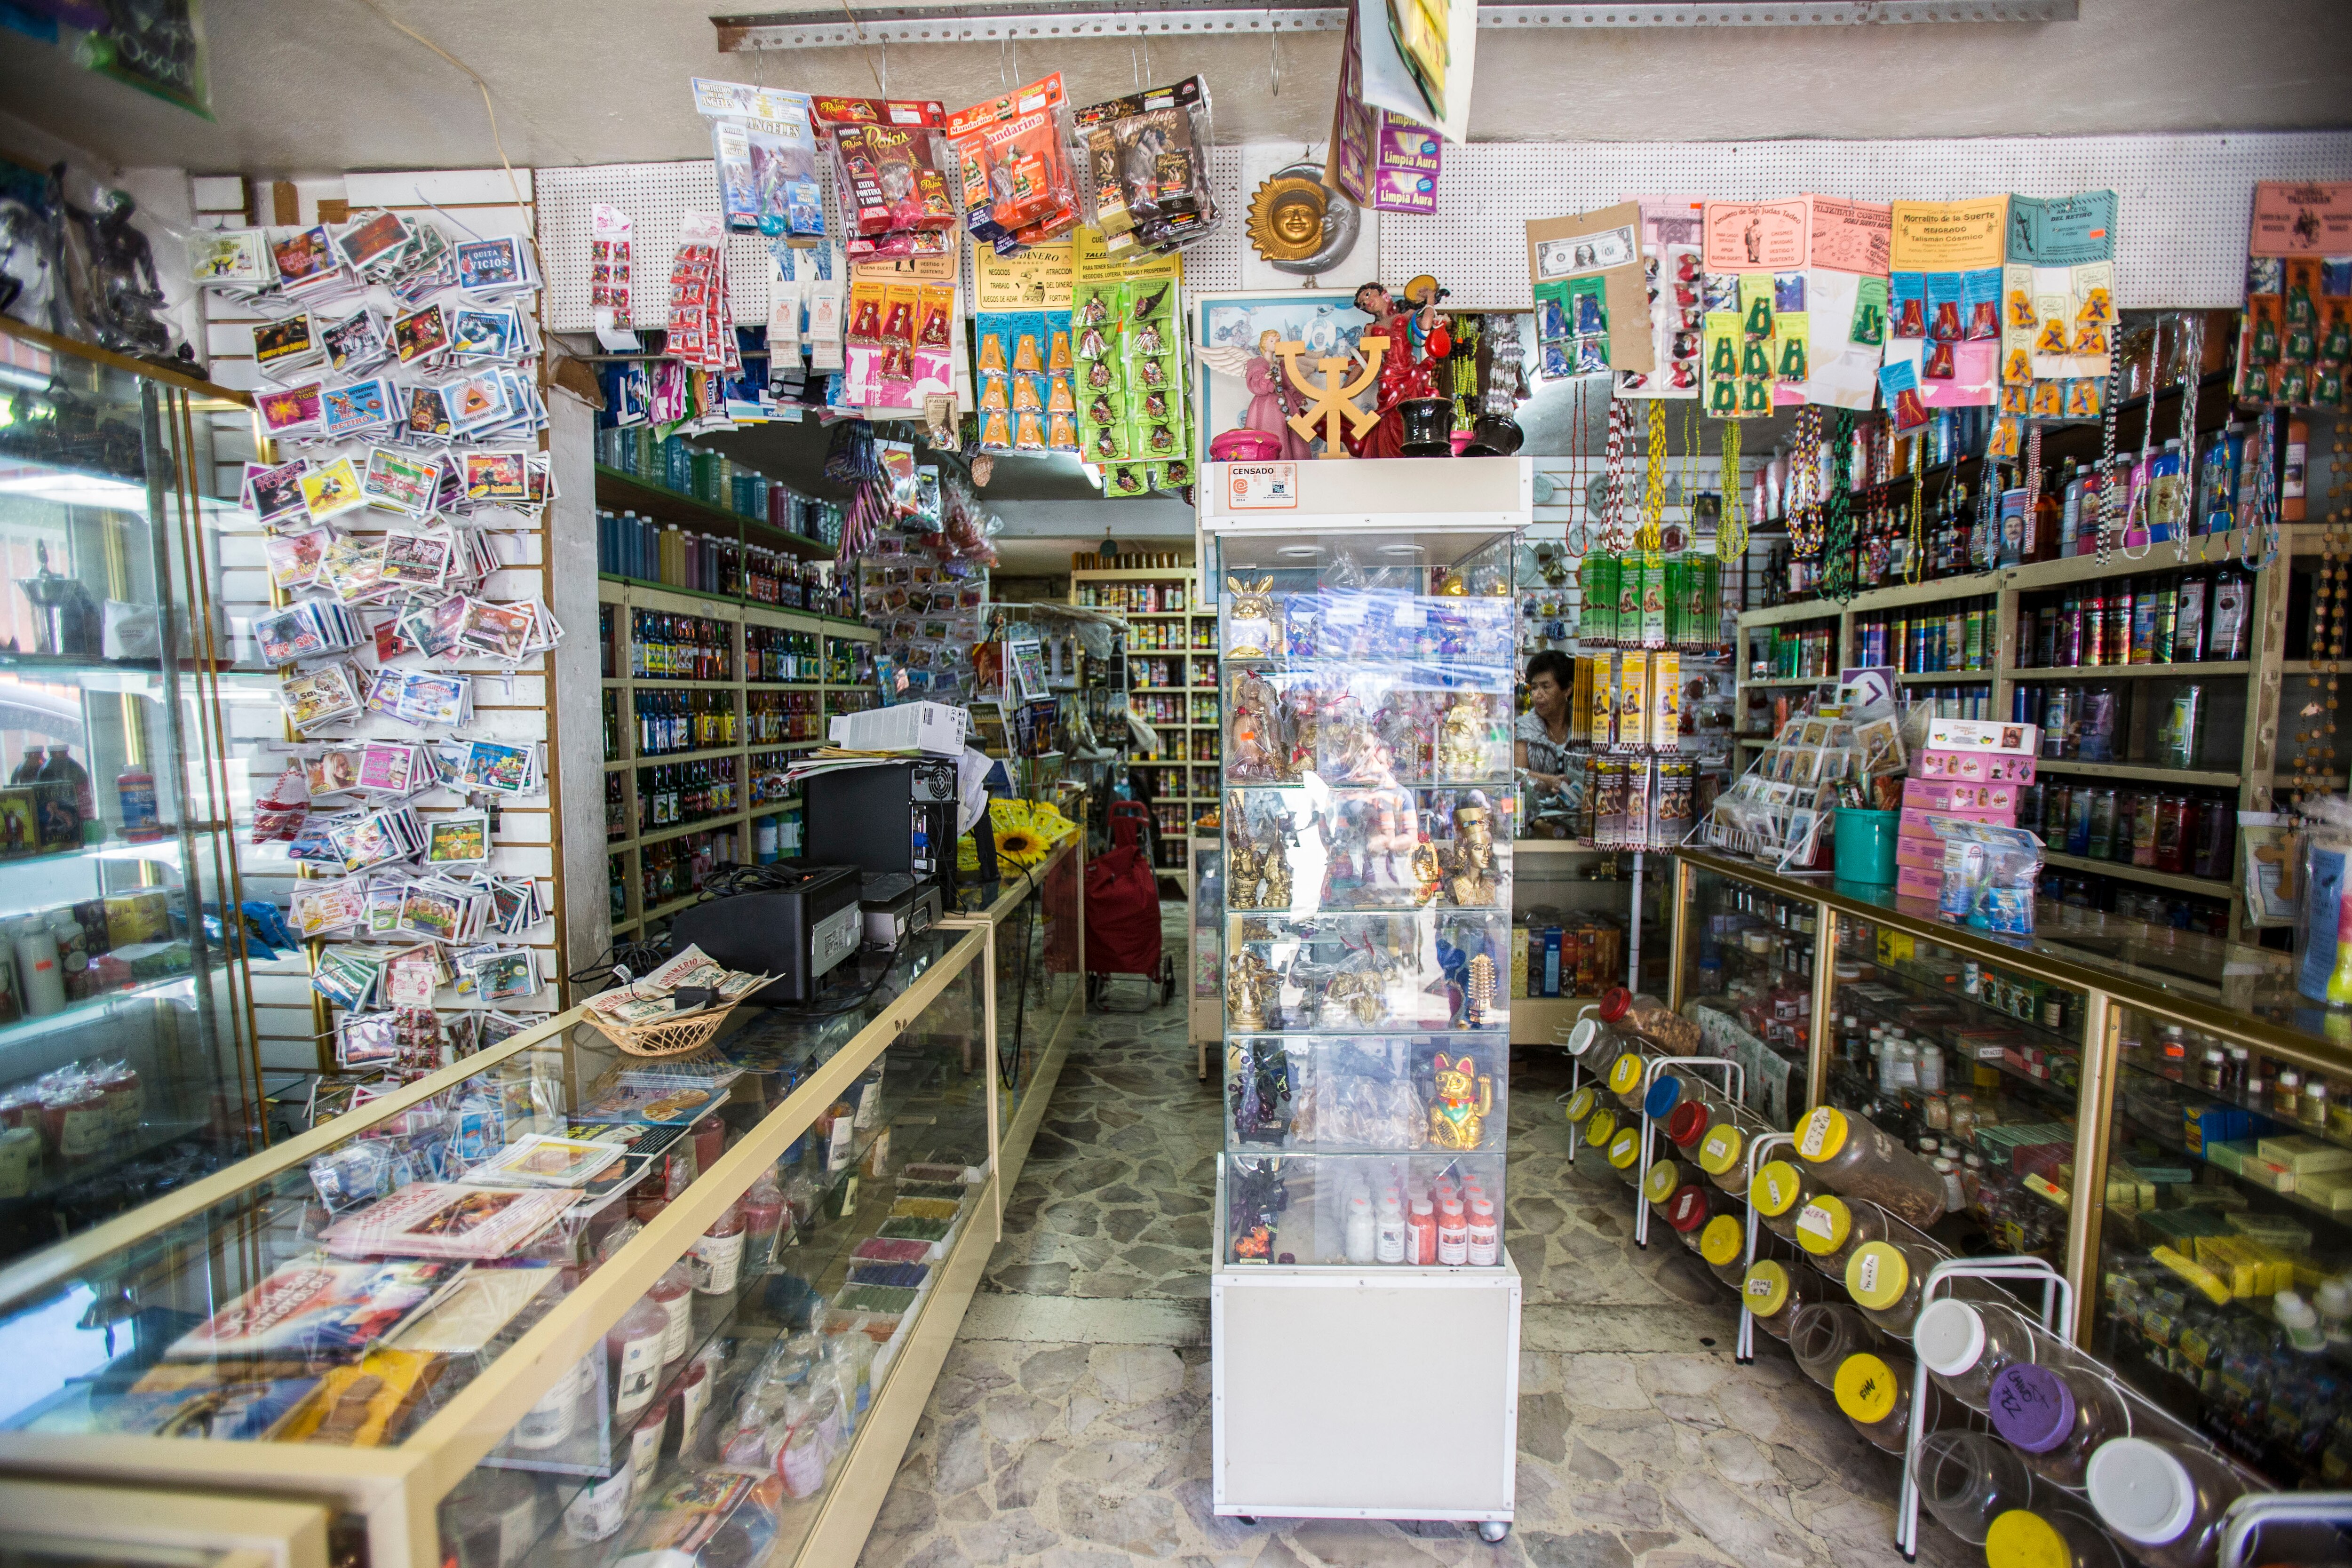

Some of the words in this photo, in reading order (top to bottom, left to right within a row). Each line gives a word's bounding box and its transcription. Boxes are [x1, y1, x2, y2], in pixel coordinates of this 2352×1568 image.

[698, 82, 731, 94] PROTECCION
[701, 96, 734, 108] ANGELES
[820, 102, 847, 116] Rojas
[723, 126, 744, 135] colonia
[746, 117, 800, 138] ANGELES
[951, 115, 992, 134] Mandarina
[1115, 110, 1177, 138] Chocolate
[1091, 129, 1110, 140] colonia
[842, 140, 863, 152] Rojas
[862, 126, 912, 157] Rojas
[725, 148, 748, 157] ANGELES
[1020, 154, 1033, 163] JABON
[1385, 151, 1414, 167] Limpia
[1416, 155, 1437, 169] Aura
[1015, 161, 1041, 174] Mandarina
[921, 180, 942, 191] Rojas
[1381, 190, 1411, 206] Limpia
[1412, 192, 1433, 206] Aura
[972, 213, 985, 222] TOILETTE
[1714, 209, 1739, 226] Amuleto
[1762, 207, 1781, 216] Judas
[1782, 209, 1801, 224] Tadeo
[1964, 212, 1994, 220] Suerte
[279, 251, 305, 266] QUITA
[474, 250, 498, 259] QUITA
[1020, 252, 1059, 262] DINERO
[286, 253, 323, 271] CALZON
[469, 258, 509, 270] VICIOS
[298, 390, 318, 400] TODO
[331, 416, 370, 430] RETIRO
[453, 415, 475, 427] REVERSIBLE
[260, 469, 302, 492] TODO
[491, 485, 521, 493] hechizos
[368, 757, 388, 770] TAPA
[365, 767, 390, 781] BOCAS
[436, 834, 455, 842] TRIPLE
[659, 957, 699, 986] SAHUMERIO
[361, 1188, 438, 1231] AMOROSA
[397, 1193, 445, 1218] Rituales
[405, 1214, 423, 1226] del
[423, 1199, 452, 1215] Amor
[249, 1275, 330, 1336] amorosos
[1860, 1378, 1875, 1401] ANIS
